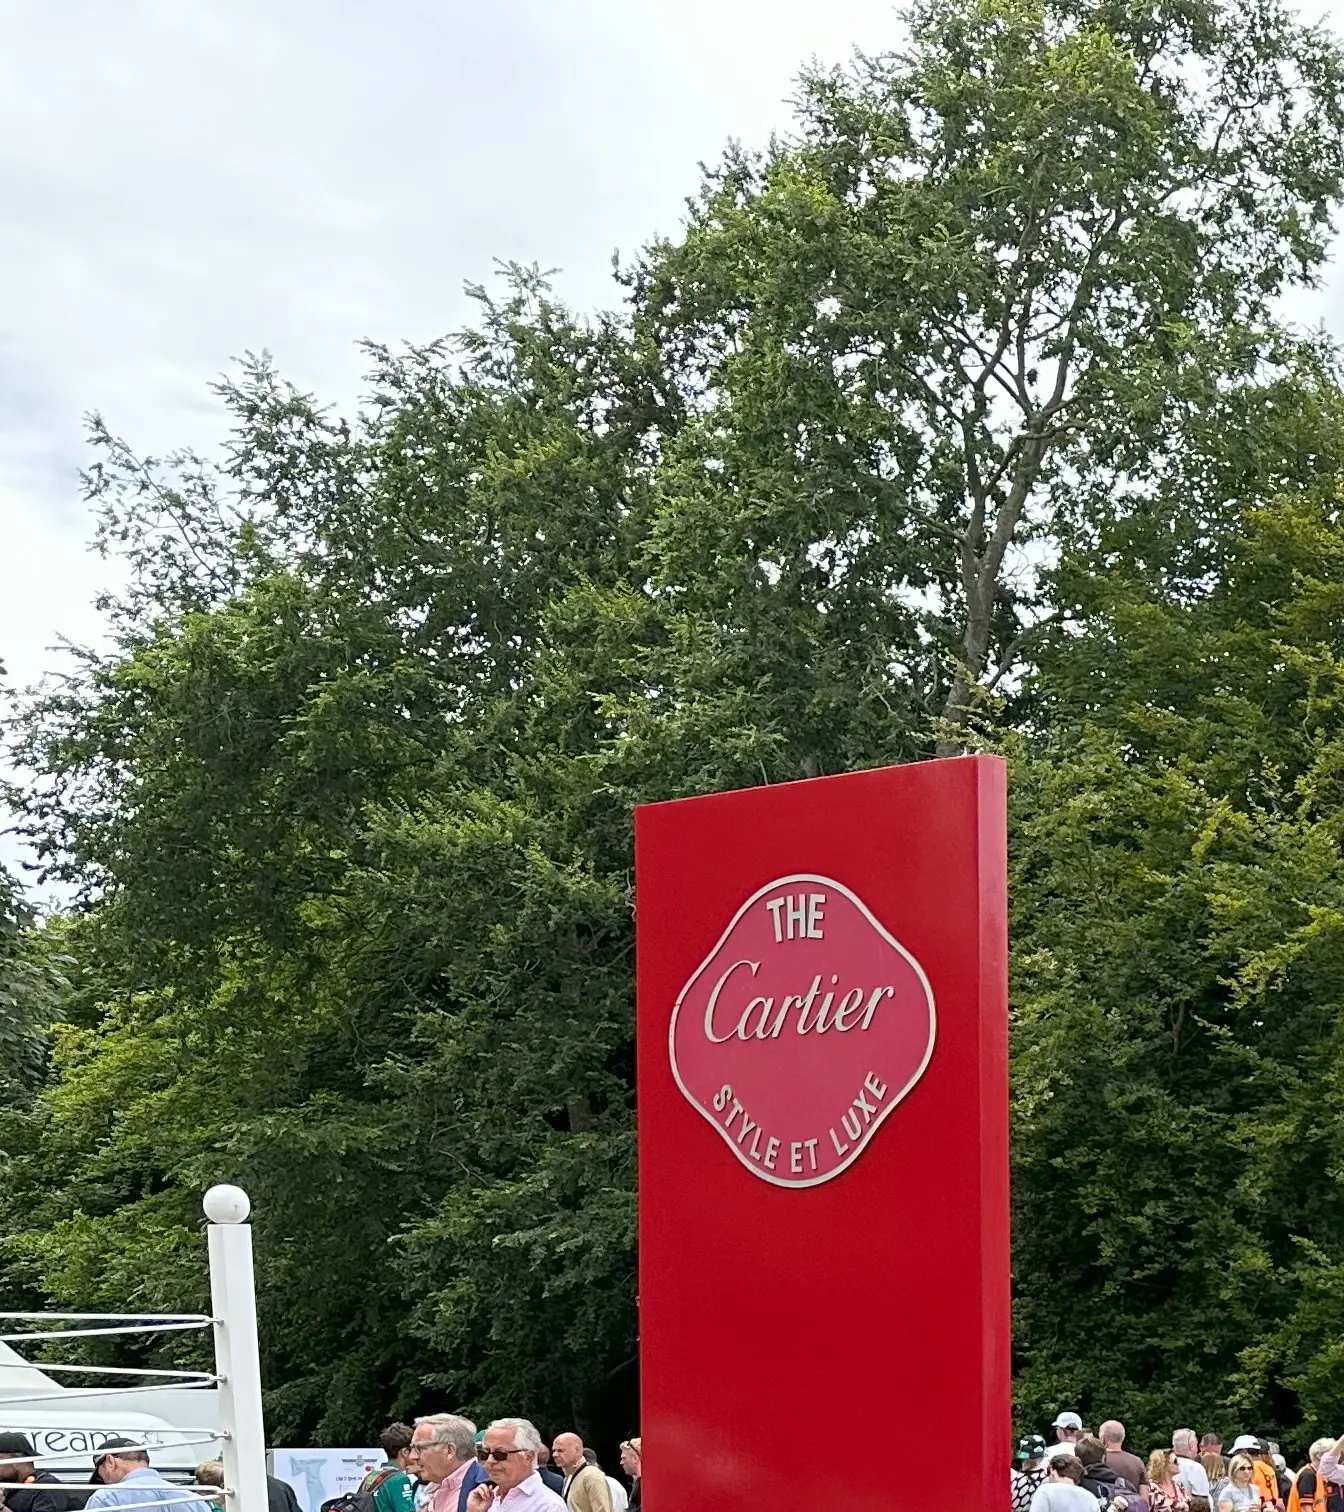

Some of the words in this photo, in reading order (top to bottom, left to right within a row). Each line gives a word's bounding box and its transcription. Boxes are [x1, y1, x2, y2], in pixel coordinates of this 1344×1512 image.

[766, 893, 826, 943] THE
[704, 960, 895, 1044] Cartier
[712, 1084, 780, 1170] STYLE
[790, 1138, 819, 1173] ET
[829, 1071, 888, 1156] LUXE
[23, 1431, 121, 1452] ream
